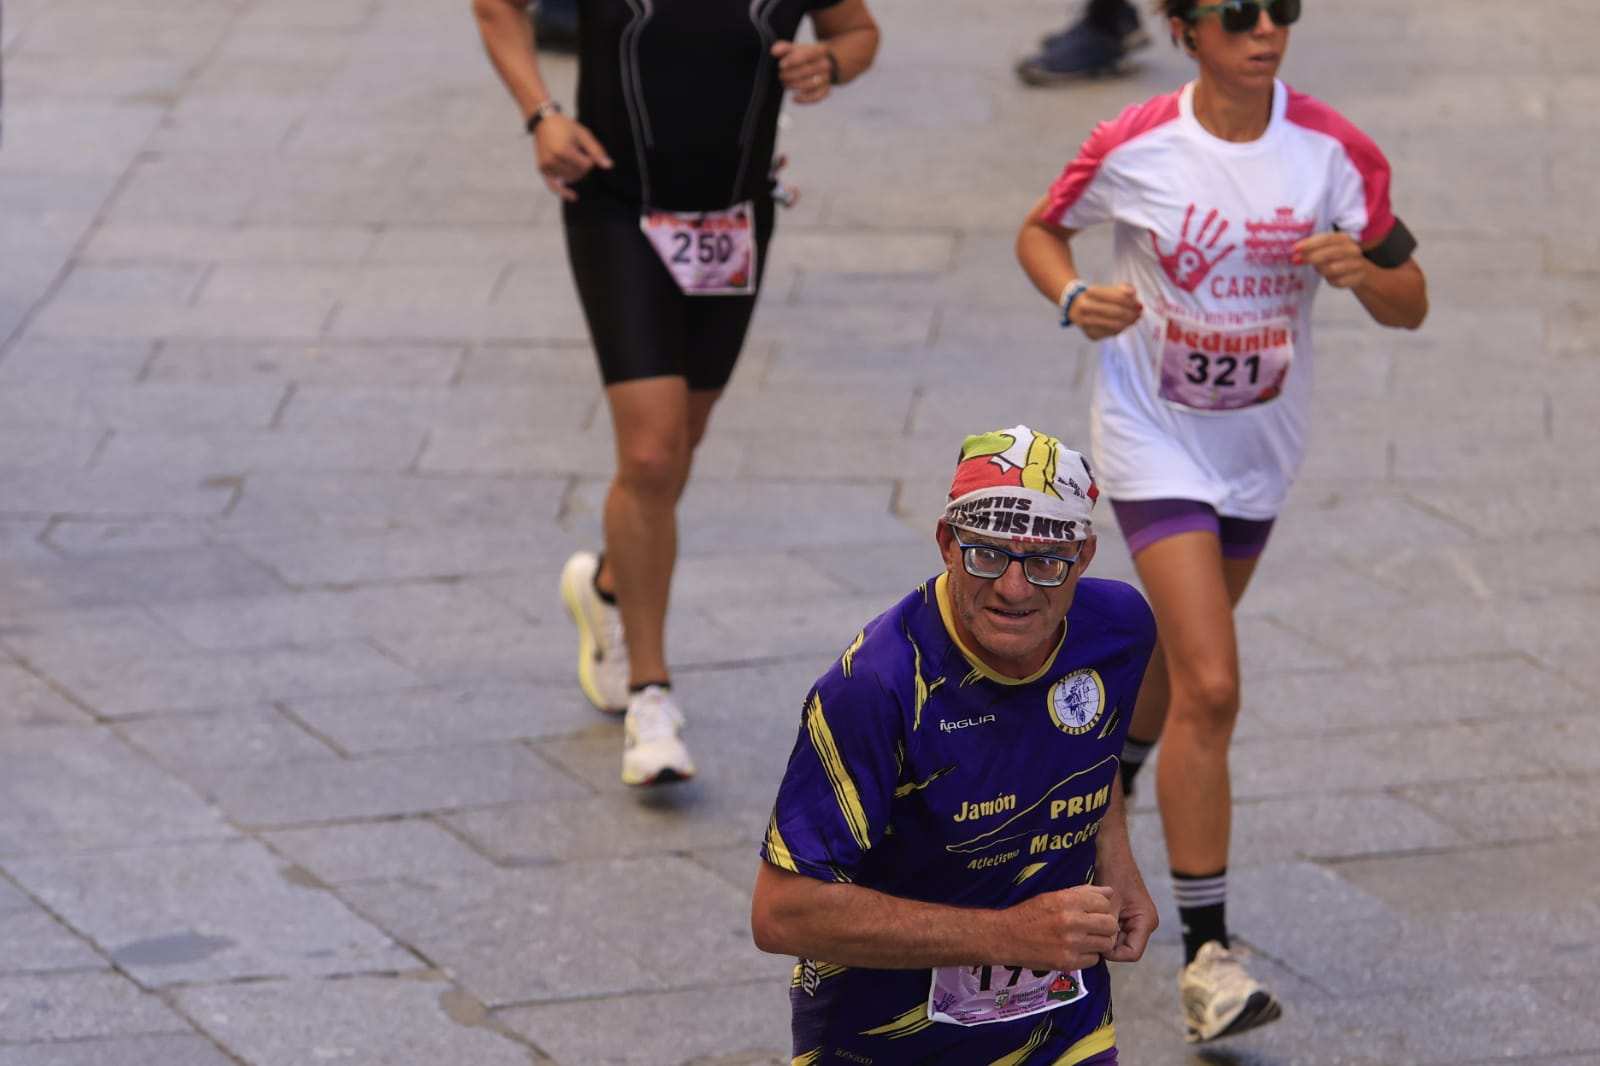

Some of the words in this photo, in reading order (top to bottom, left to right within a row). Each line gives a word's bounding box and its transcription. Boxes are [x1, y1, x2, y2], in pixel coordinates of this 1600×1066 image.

[672, 233, 734, 263] 250
[1185, 352, 1261, 387] 321
[957, 497, 1032, 513] SALMAN
[947, 507, 1030, 535] SILVEST
[1031, 516, 1077, 541] SAN
[953, 792, 1017, 823] Jamón
[1050, 785, 1110, 819] PRIM
[967, 848, 1020, 870] Atletismo
[980, 965, 1052, 991] 19
